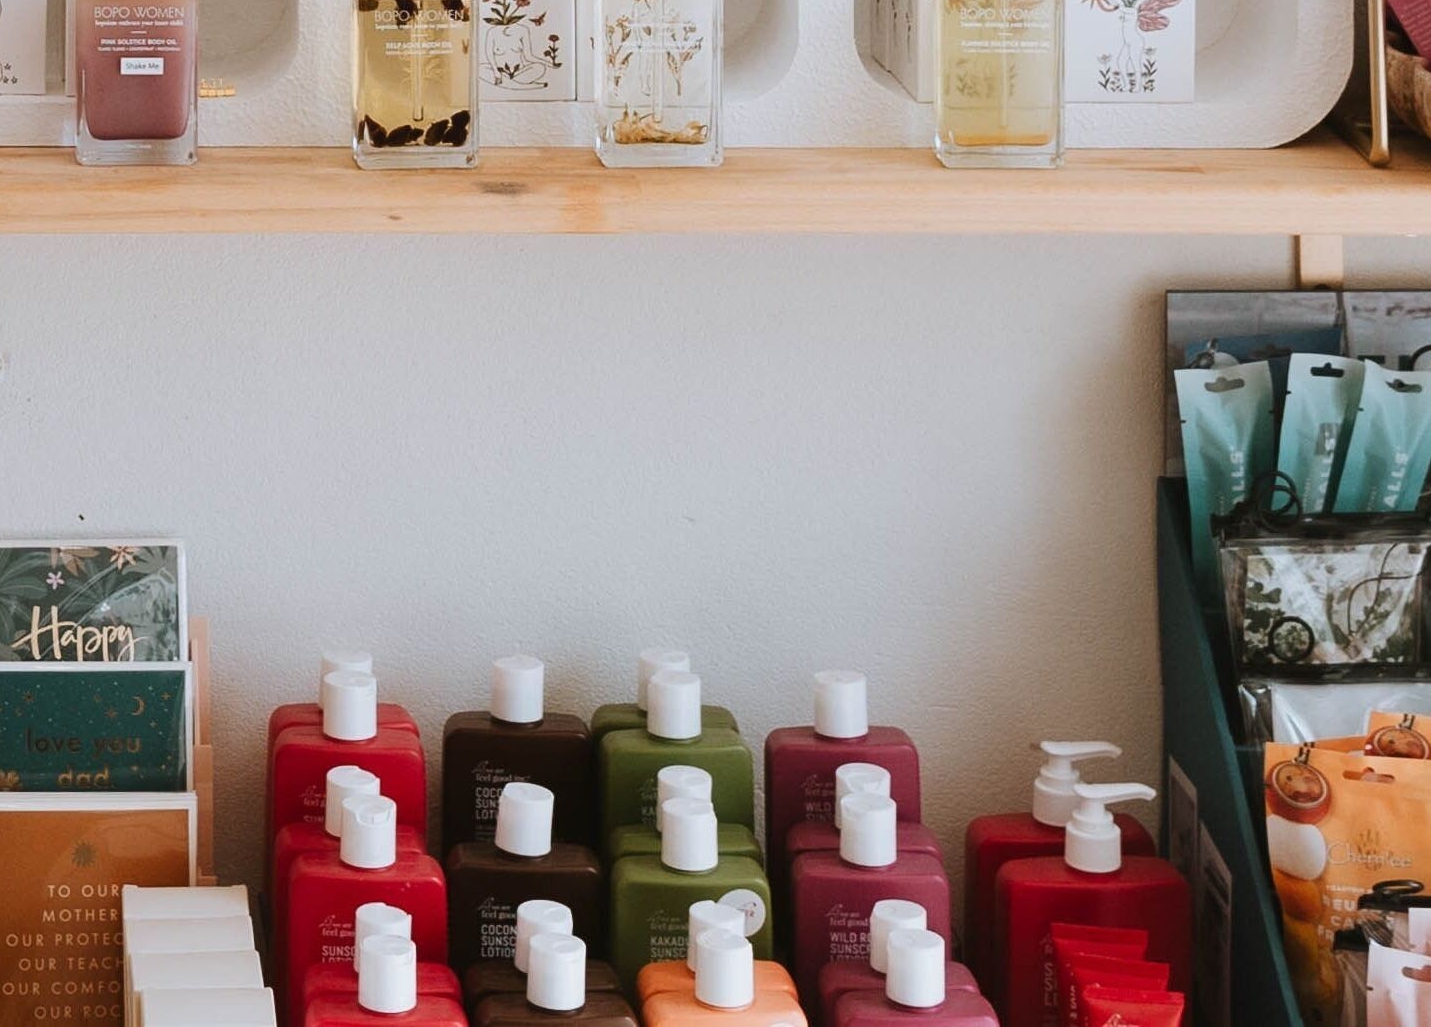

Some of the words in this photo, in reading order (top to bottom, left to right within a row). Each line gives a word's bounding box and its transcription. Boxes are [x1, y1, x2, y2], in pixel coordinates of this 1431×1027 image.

[94, 6, 130, 20] BOPO
[133, 6, 185, 20] WOMEN
[374, 10, 411, 22] BOPO
[414, 10, 465, 22] WOMEN
[117, 38, 147, 46] SOLSTICE
[147, 38, 166, 46] BODY
[125, 62, 146, 70] Shake
[12, 605, 147, 662] Happy
[25, 728, 82, 754] love
[90, 734, 143, 759] you
[477, 773, 491, 782] feel
[491, 773, 513, 784] good
[47, 884, 71, 899] TO
[81, 883, 119, 899] OUR
[481, 909, 497, 918] feel
[829, 917, 846, 926] feel
[322, 928, 338, 937] feel
[830, 932, 858, 943] WILD
[5, 933, 44, 948] OUR
[18, 957, 57, 971] OUR
[2, 981, 41, 996] OUR
[33, 1005, 73, 1020] OUR
